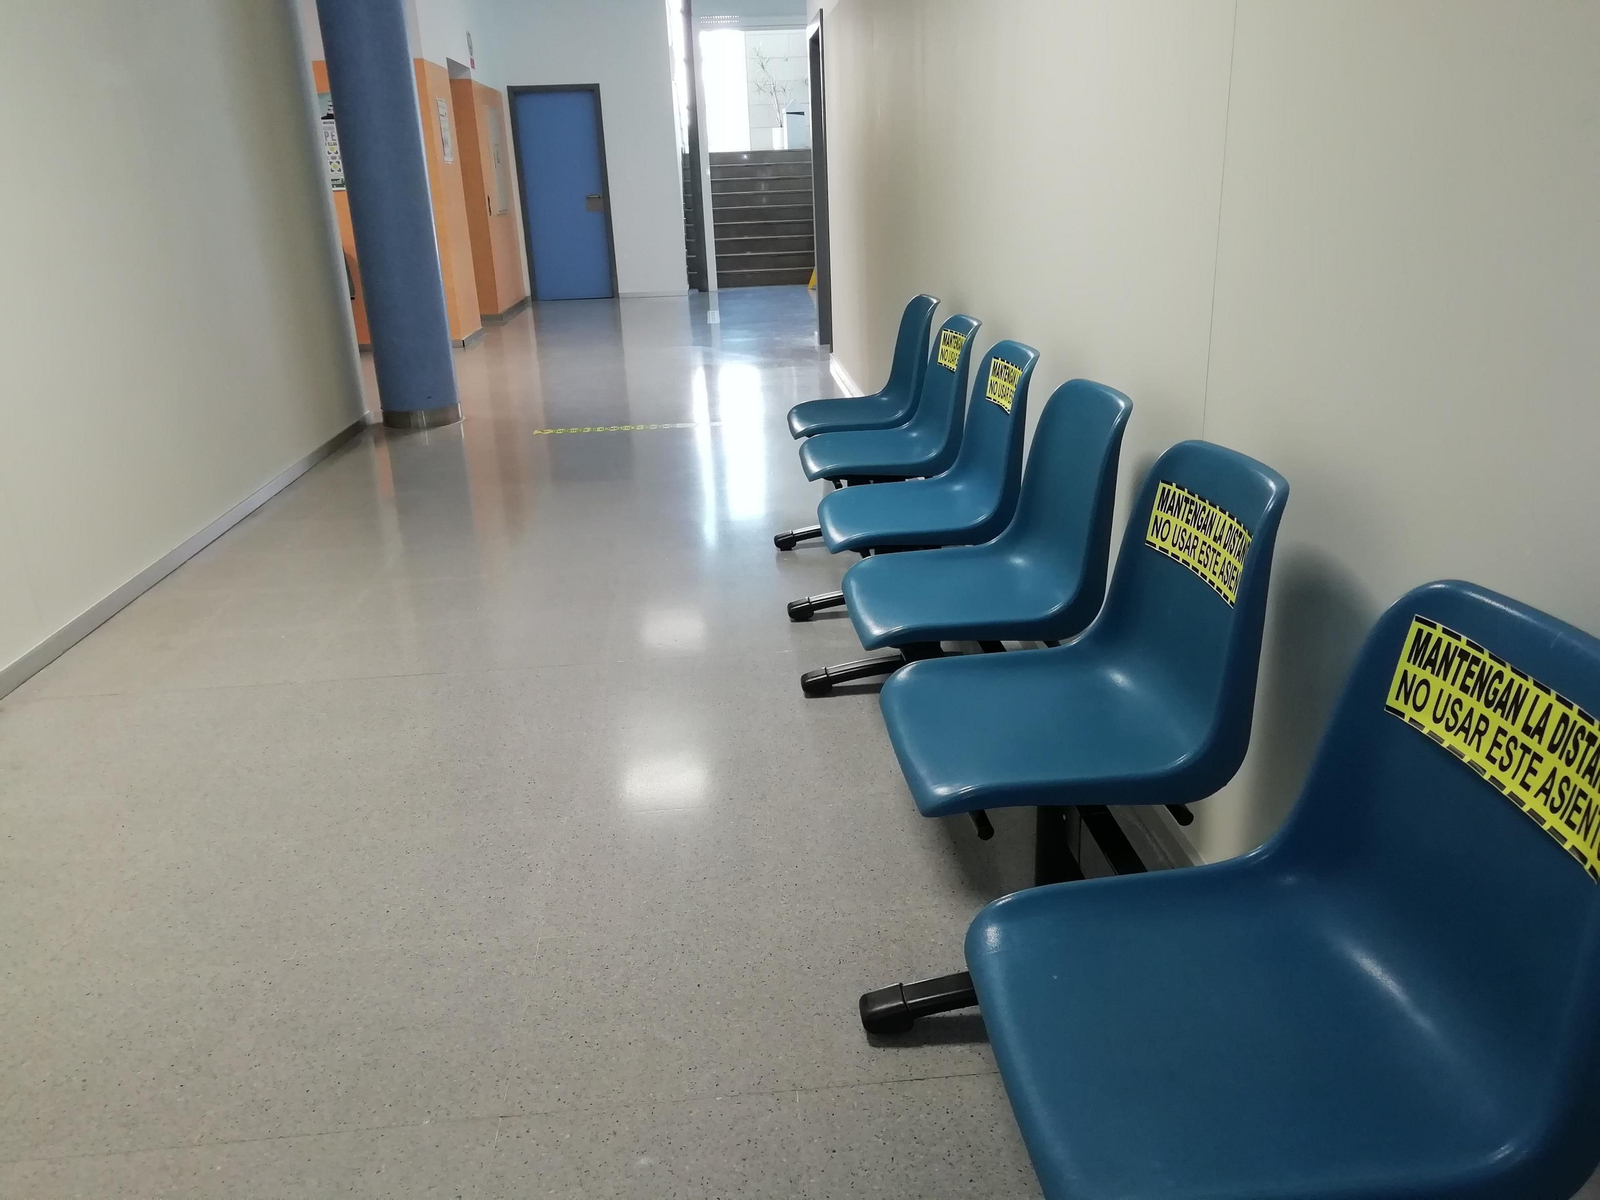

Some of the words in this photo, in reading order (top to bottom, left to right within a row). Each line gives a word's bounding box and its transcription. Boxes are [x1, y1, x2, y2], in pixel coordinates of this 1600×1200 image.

[940, 348, 949, 362] NO
[988, 379, 998, 395] NO
[1151, 515, 1171, 542] NO
[1171, 524, 1199, 560] USAR
[1197, 540, 1221, 577] ESTE
[1157, 486, 1217, 539] MANTENGAN
[1212, 516, 1227, 546] LA
[1406, 628, 1529, 726] MANTENGAN
[1521, 693, 1553, 745] LA
[1547, 711, 1600, 795] DISTA
[1395, 669, 1431, 713] NO
[1432, 688, 1490, 753] USAR
[1485, 727, 1543, 793] ESTE
[1534, 766, 1600, 862] ASIENT
